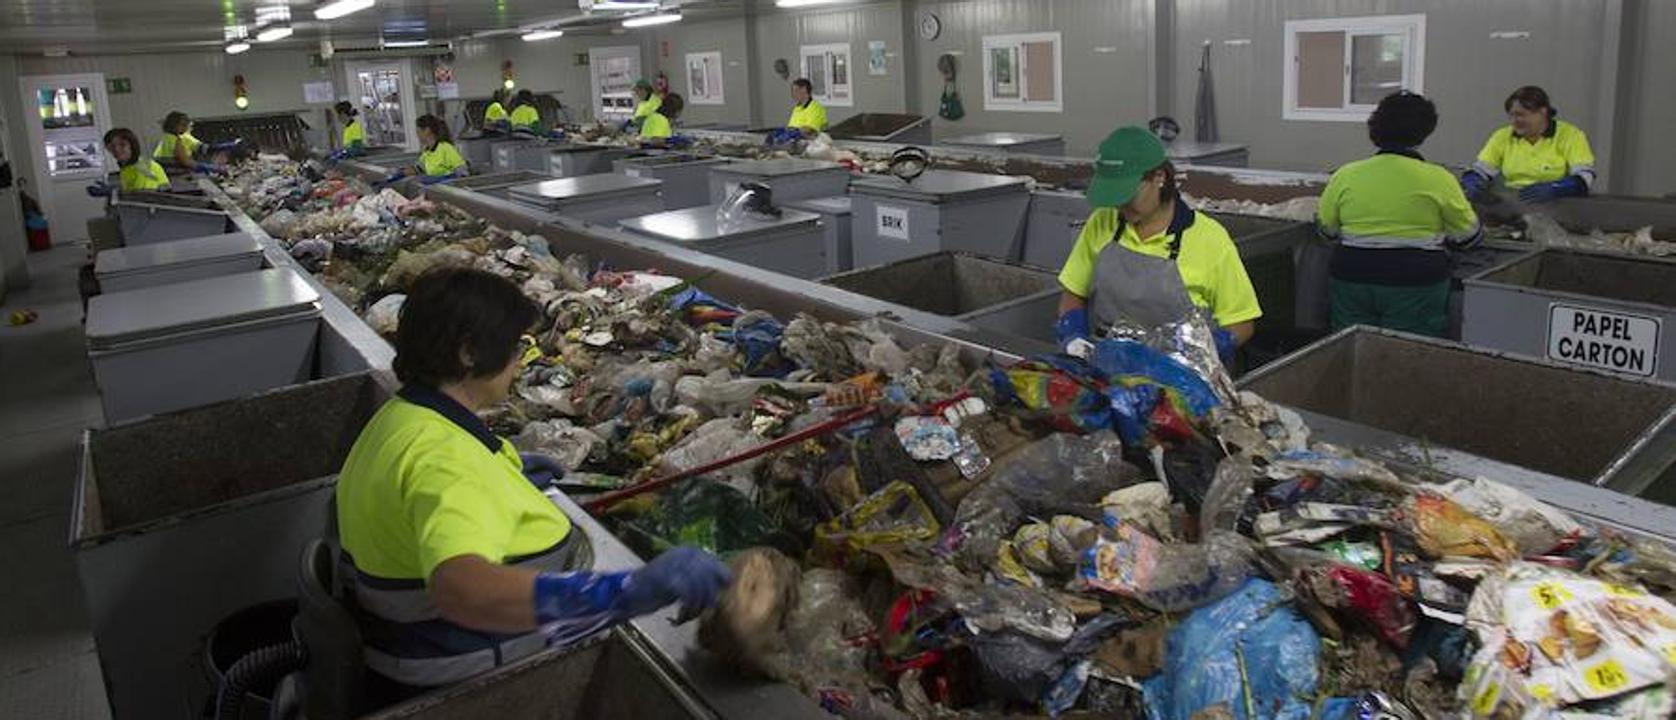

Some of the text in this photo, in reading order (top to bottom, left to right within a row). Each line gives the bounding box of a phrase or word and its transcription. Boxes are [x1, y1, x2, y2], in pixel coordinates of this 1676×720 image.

[882, 215, 903, 231] BRIK
[1573, 312, 1632, 341] PAPEL
[1558, 336, 1645, 371] CARTON
